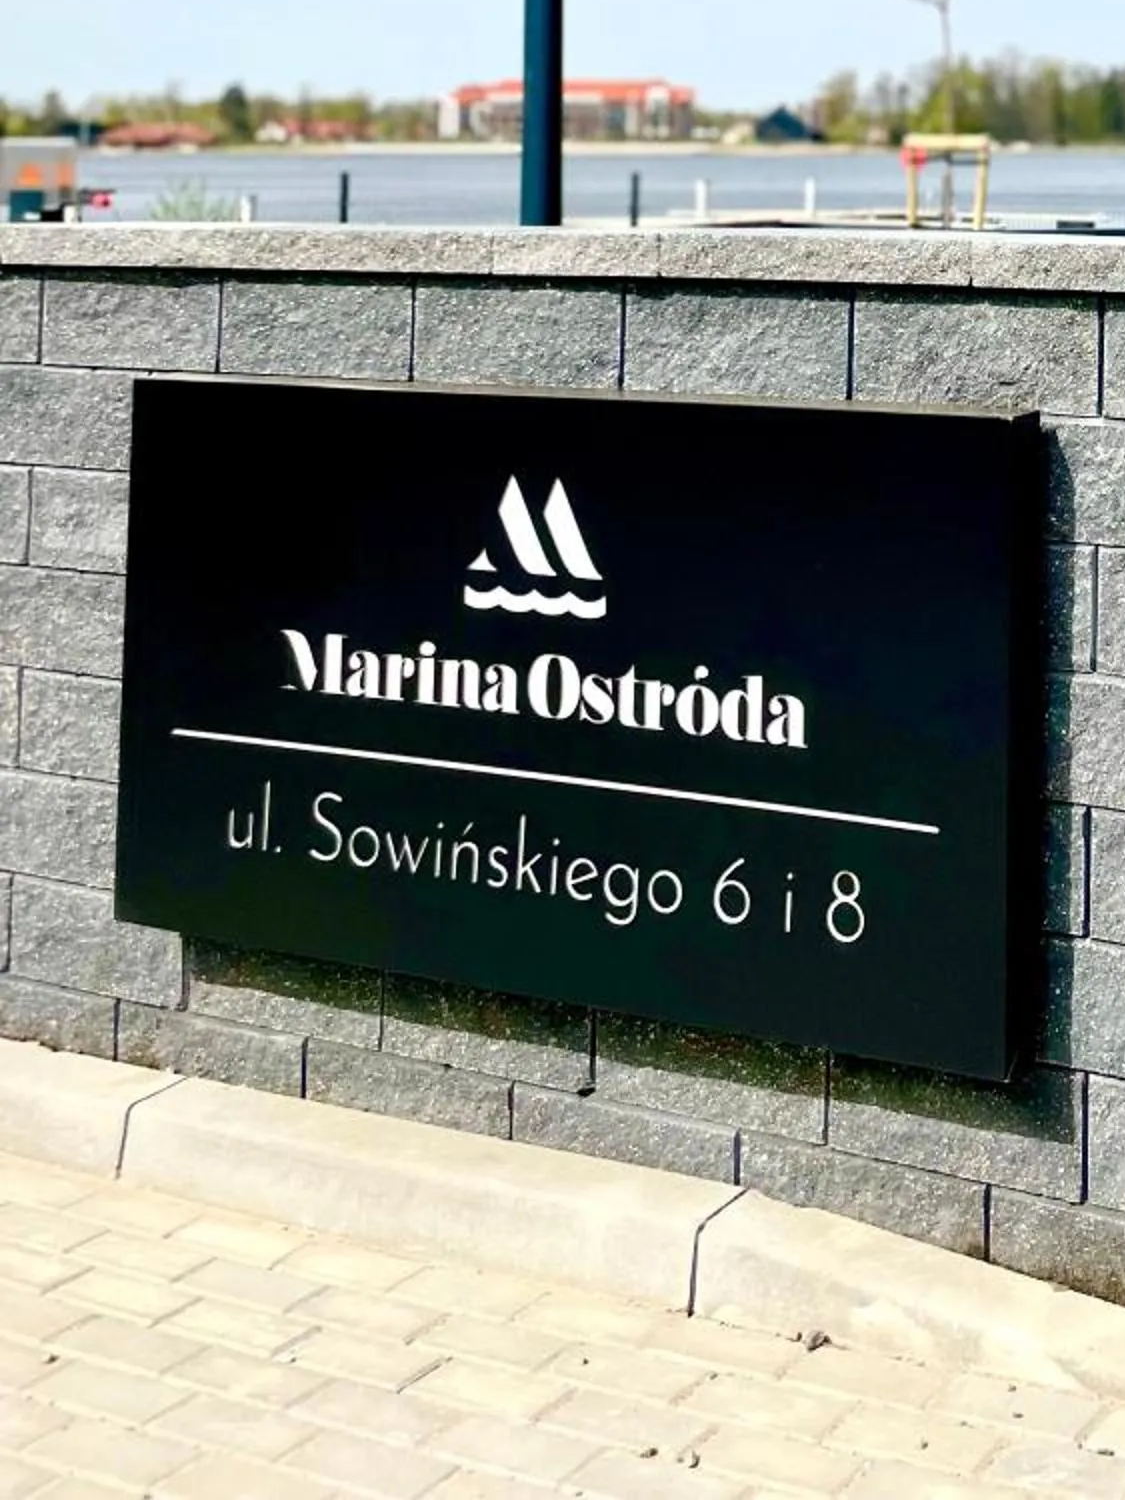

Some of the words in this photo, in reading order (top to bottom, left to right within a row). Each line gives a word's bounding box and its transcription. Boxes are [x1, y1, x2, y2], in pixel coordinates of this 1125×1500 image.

[280, 628, 520, 716] Marina
[527, 653, 809, 750] Ostróda
[226, 780, 283, 853] ul.
[308, 790, 684, 927] Sowińskiego
[712, 856, 752, 926] 6
[784, 871, 794, 934] i
[825, 869, 866, 944] 8
